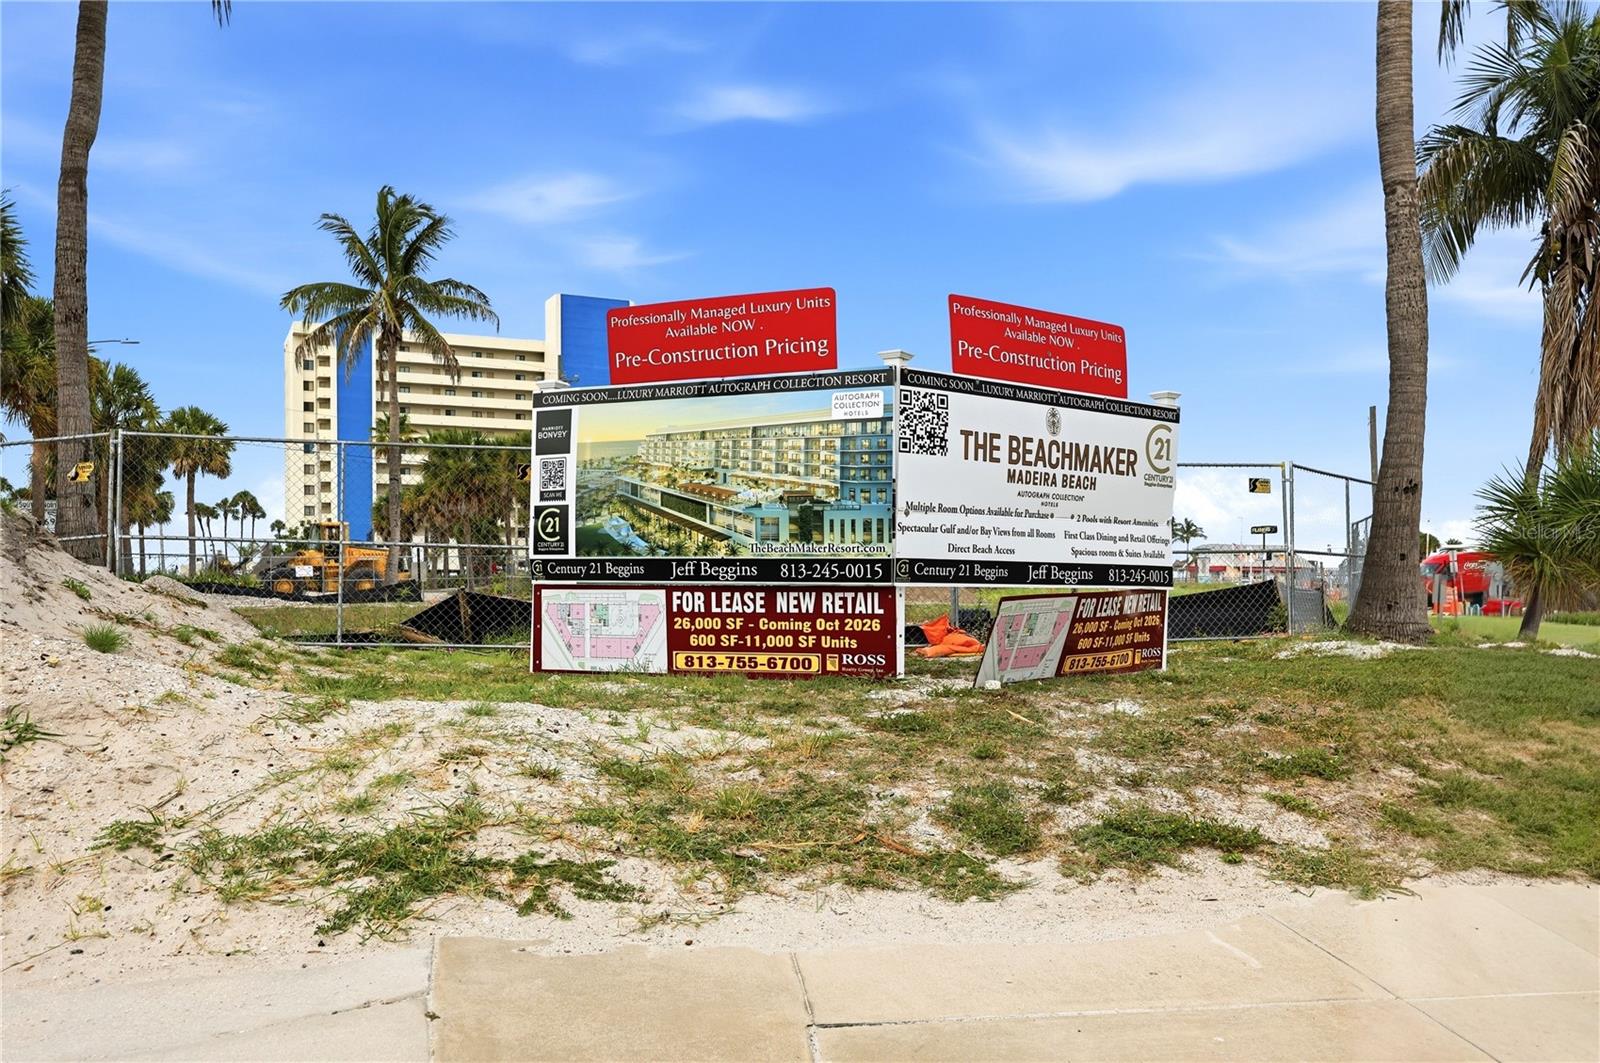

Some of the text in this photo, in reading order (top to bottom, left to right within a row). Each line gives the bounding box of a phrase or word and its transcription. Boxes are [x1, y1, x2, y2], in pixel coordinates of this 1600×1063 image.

[611, 297, 831, 328] Professionally Managed Luxury Units
[665, 319, 756, 338] Available NOW
[953, 302, 1122, 343] Professionally Managed Luxury Units
[1004, 327, 1074, 348] Available NOW
[615, 337, 829, 368] Pre-Construction Pricing
[958, 340, 1122, 384] Pre-Construction Pricing
[542, 393, 580, 405] COMING
[655, 385, 707, 397] MARRIOTT
[708, 381, 770, 394] AUTOGRAPH
[774, 376, 842, 390] COLLECTION
[845, 373, 887, 385] RESORT
[834, 393, 880, 401] AUTOGRAPH
[907, 374, 947, 388] COMING
[1016, 389, 1057, 404] MARRIOTT
[1059, 395, 1105, 411] AUTOGRAPH
[1105, 401, 1152, 416] COLLECTION
[1152, 408, 1177, 420] RESORT
[834, 401, 880, 409] COLLECTION
[537, 430, 567, 439] BONVOY
[960, 429, 1138, 477] THE BEACHMAKER
[1007, 469, 1097, 491] MADEIRA BEACH
[1144, 473, 1169, 483] CENTURY
[1017, 491, 1050, 499] AUTOGRAPH
[905, 501, 1049, 519] Multiple Room Options Available for Purchase
[1076, 514, 1159, 527] 2 Pools with Resort Amenities
[897, 522, 939, 534] Spectacular
[940, 524, 956, 534] Gulf
[956, 525, 979, 535] and/or
[980, 526, 991, 536] Bay
[992, 527, 1011, 537] Views
[1011, 527, 1026, 537] from
[1036, 529, 1056, 538] Rooms
[1064, 530, 1170, 547] First Class Dining and Retail Offerings
[750, 542, 886, 554] TheBeachMakerResort.com
[947, 543, 1015, 555] Direct Beach Access
[1071, 547, 1098, 558] Spacious
[1118, 549, 1124, 557] &
[1125, 549, 1141, 558] Suites
[1142, 550, 1166, 559] Available
[547, 562, 645, 578] Century 21 Beggins
[670, 561, 758, 580] Jeff Beggins
[780, 562, 883, 579] 813-245-0015
[914, 562, 1009, 580] Century 21 Beggins
[1027, 565, 1094, 584] Jeff Beggins
[1108, 568, 1169, 584] 813-245-0015
[672, 591, 884, 615] FOR LEASE NEW RETAIL
[1076, 593, 1162, 618] FOR LEASE NEW RETAIL
[673, 617, 721, 632] 26,000
[726, 617, 744, 629] SF
[759, 617, 812, 633] Coming
[816, 618, 840, 631] Oct
[844, 618, 881, 632] 2026
[1072, 621, 1099, 635] 26,000
[1099, 620, 1110, 632] SF
[689, 634, 858, 649] 600 SF-11,000 SF Units
[1077, 638, 1093, 650] 600
[1125, 632, 1133, 644] SF
[842, 653, 886, 666] ROSS
[1068, 652, 1129, 670] 813-755-6700
[1142, 647, 1161, 658] ROSS
[684, 655, 812, 670] 813-755-6700
